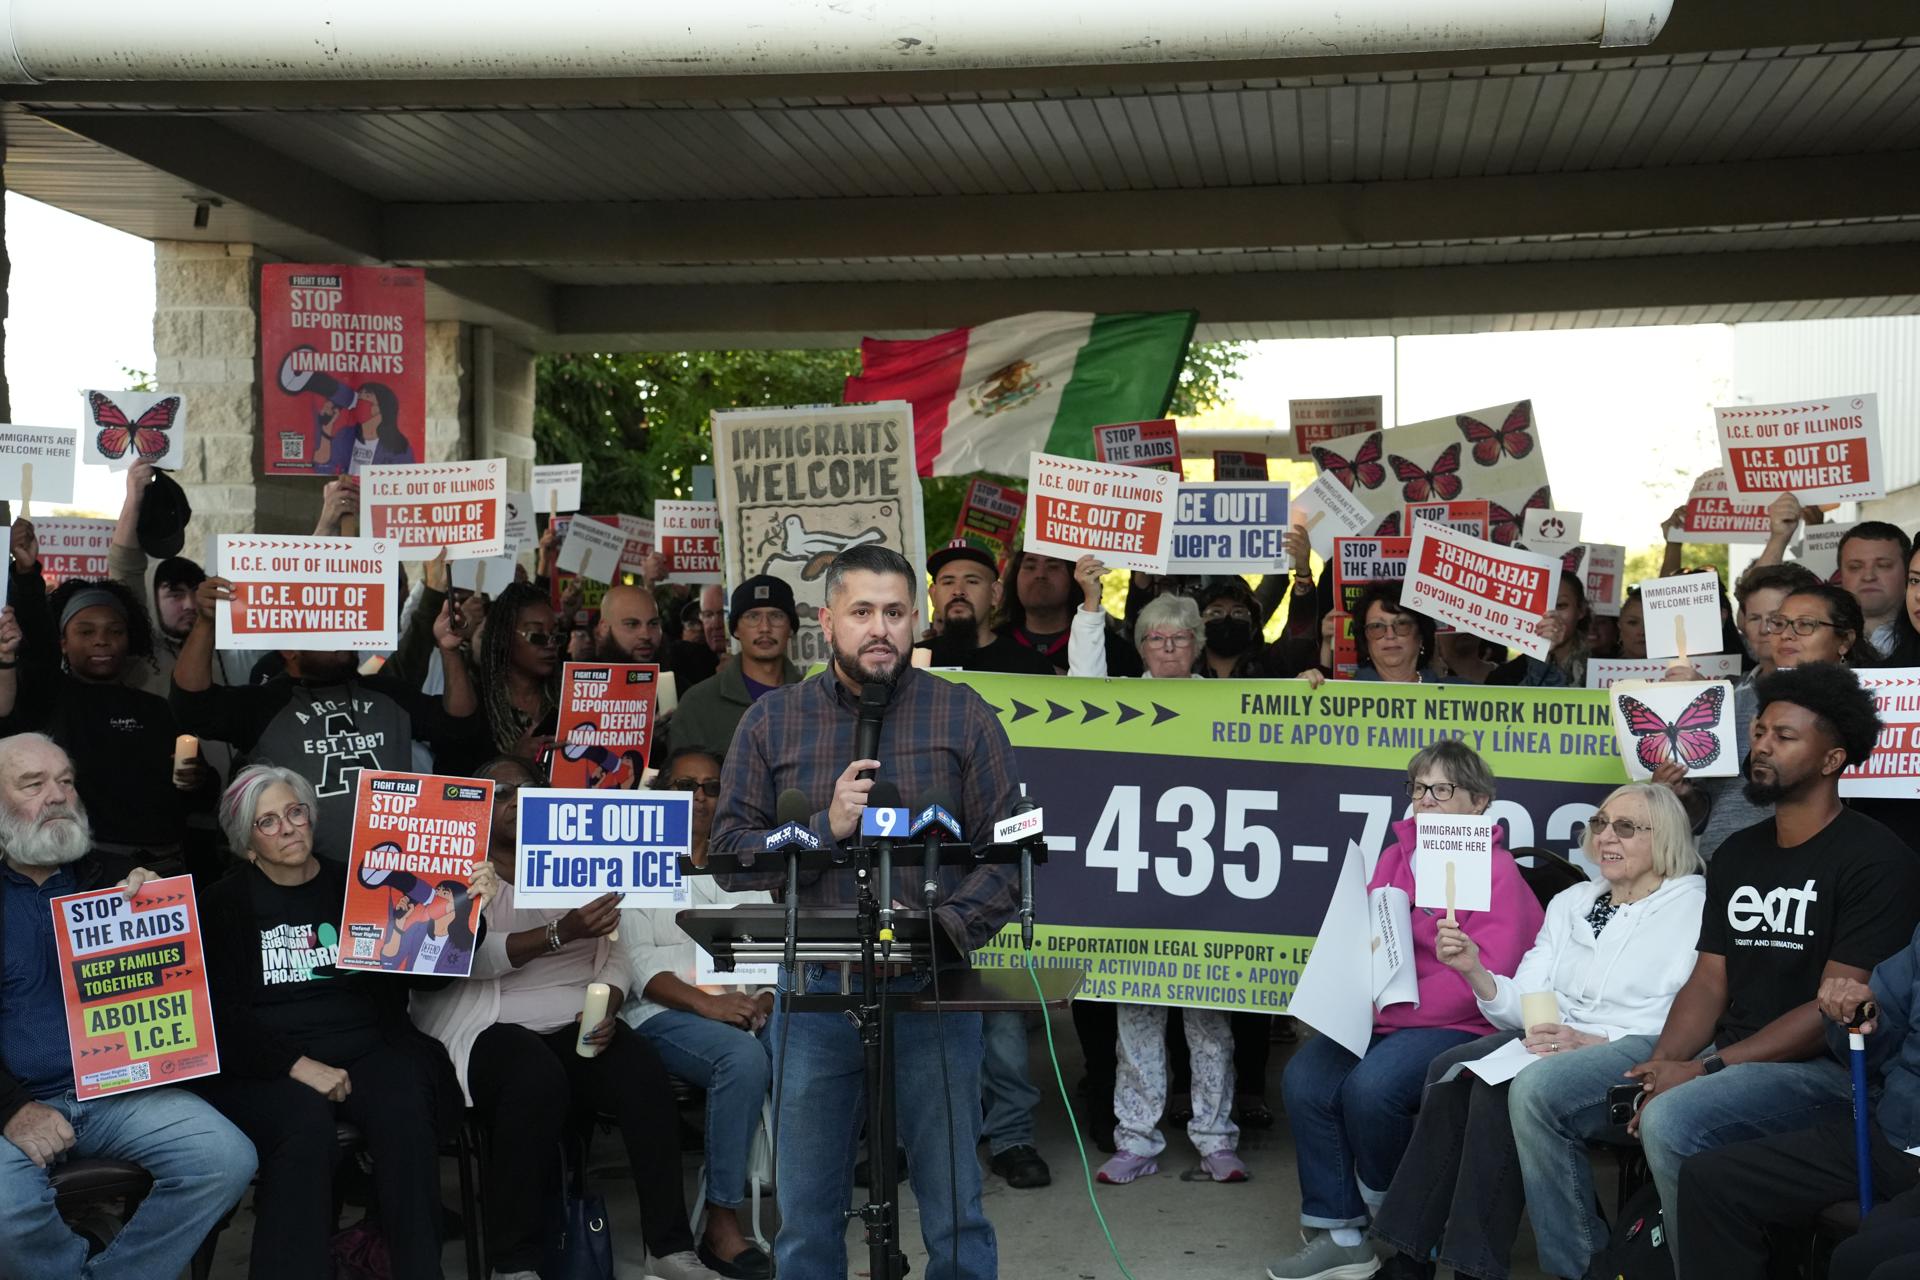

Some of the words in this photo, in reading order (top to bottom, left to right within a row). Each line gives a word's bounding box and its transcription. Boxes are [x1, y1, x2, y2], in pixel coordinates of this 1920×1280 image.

[293, 276, 316, 285] FIGHT
[317, 277, 336, 286] FEAR
[291, 290, 342, 311] STOP
[292, 312, 403, 331] DEPORTATIONS
[331, 332, 404, 354] DEFEND
[292, 352, 404, 374] IMMIGRANTS
[1105, 428, 1136, 444] STOP
[1727, 425, 1754, 438] I.C.E.
[1756, 424, 1778, 438] OUT
[1784, 422, 1800, 436] OF
[1804, 416, 1862, 434] ILLINOIS
[0, 433, 54, 445] MMIGRANTS
[57, 436, 76, 446] ARE
[732, 420, 900, 462] IMMIGRANTS
[46, 448, 71, 457] HERE
[1107, 446, 1133, 461] THE
[1134, 441, 1173, 457] RAIDS
[1742, 448, 1780, 468] I.C.E.
[1784, 446, 1820, 467] OUT
[1826, 444, 1849, 462] OF
[372, 483, 402, 496] I.C.E.
[406, 482, 428, 495] OUT
[434, 480, 447, 494] OF
[450, 478, 494, 492] ILLINOIS
[734, 457, 899, 502] WELCOME
[1745, 464, 1853, 490] EVERYWHERE
[1039, 473, 1063, 488] I.C.E.
[1068, 478, 1090, 494] OUT
[1094, 482, 1109, 496] OF
[1112, 485, 1163, 504] ILLINOIS
[386, 506, 427, 524] I.C.E.
[432, 505, 462, 524] OUT
[466, 504, 484, 522] OF
[1048, 500, 1082, 523] I.C.E.
[1088, 508, 1121, 528] OUT
[1124, 512, 1146, 531] OF
[1178, 493, 1206, 522] CE
[1214, 492, 1267, 522] OUT!
[1416, 508, 1445, 520] STOP
[1696, 500, 1729, 514] I.C.E.
[664, 518, 687, 528] I.C.E.
[691, 518, 712, 528] OUT
[1694, 516, 1770, 530] EVERYWHER
[64, 536, 86, 547] OUT
[90, 536, 102, 548] OF
[386, 523, 484, 547] EVERYWHERE
[1046, 521, 1144, 552] EVERYWHERE
[1174, 534, 1231, 558] uera
[1240, 530, 1282, 558] ICE!
[674, 538, 708, 554] I.C.E.
[1344, 544, 1376, 558] STOP
[44, 557, 82, 572] I.C.E.
[231, 556, 266, 572] I.C.E.
[272, 556, 301, 572] OUT
[304, 558, 320, 573] OF
[326, 558, 382, 574] ILLINOIS
[1344, 562, 1368, 577] THE
[1373, 562, 1406, 577] RAID
[1434, 560, 1454, 578] OF
[1436, 541, 1540, 590] EVERYWHERE
[1456, 572, 1488, 594] OUT
[1644, 584, 1698, 598] IMMIGRANTS
[1700, 582, 1716, 592] ARE
[248, 586, 295, 606] I.C.E.
[302, 586, 338, 606] OUT
[344, 586, 368, 606] OF
[1415, 581, 1464, 610] CHICAGO
[1494, 582, 1534, 610] I.C.E.
[1650, 596, 1692, 610] WELCOME
[1693, 593, 1714, 606] HERE
[246, 608, 368, 630] EVERYWHERE
[1467, 603, 1482, 616] OF
[1485, 610, 1508, 626] OUT
[574, 672, 590, 680] FIGHT
[592, 672, 608, 680] FEAR
[574, 682, 608, 698] STOP
[572, 699, 648, 713] DEPORTATIONS
[1241, 694, 1312, 716] FAMILY
[1320, 696, 1417, 720] SUPPORT
[1424, 700, 1524, 724] NETWORK
[1533, 702, 1614, 726] HOTLIN
[600, 713, 646, 730] DEFEND
[568, 730, 645, 746] IMMIGRANTS
[1212, 722, 1251, 742] RED
[1259, 724, 1283, 744] DE
[1291, 724, 1360, 747] APOYO
[1472, 730, 1485, 752] Y
[1492, 726, 1552, 754] LÍNEA
[373, 780, 394, 790] FIGHT
[396, 782, 416, 792] FEAR
[371, 794, 416, 814] STOP
[369, 814, 476, 836] DEPORTATIONS
[548, 803, 593, 842] ICE
[602, 804, 664, 842] OUT!
[782, 826, 792, 837] 32
[875, 808, 896, 837] 9
[1420, 825, 1472, 837] IMMIGRANTS
[1474, 826, 1490, 838] ARE
[406, 834, 475, 856] DEFEND
[1422, 840, 1463, 852] WELCOME
[1465, 841, 1486, 852] HERE
[364, 851, 472, 877] IMMIGRANTS
[526, 850, 622, 888] ¡Fuera
[632, 851, 682, 888] ICE!
[72, 896, 123, 923] STOP
[72, 924, 114, 950] THE
[119, 912, 185, 939] RAIDS
[262, 944, 338, 970] IMMIGRA
[1048, 936, 1148, 954] DEPORTATION
[1154, 940, 1198, 958] LEGAL
[1204, 942, 1274, 962] SUPPORT
[82, 960, 115, 978] KEEP
[120, 948, 180, 972] FAMILIES
[1099, 958, 1178, 978] ACTIVIDAD
[1183, 963, 1201, 980] DE
[1206, 964, 1230, 982] ICE
[1248, 968, 1299, 986] APOYO
[84, 972, 154, 996] TOGETHER
[263, 968, 312, 986] PROJECT
[1122, 981, 1161, 998] PARA
[1167, 984, 1246, 1004] SERVICIOS
[92, 994, 186, 1032] ABOLISH
[134, 1022, 191, 1052] I.C.E.
